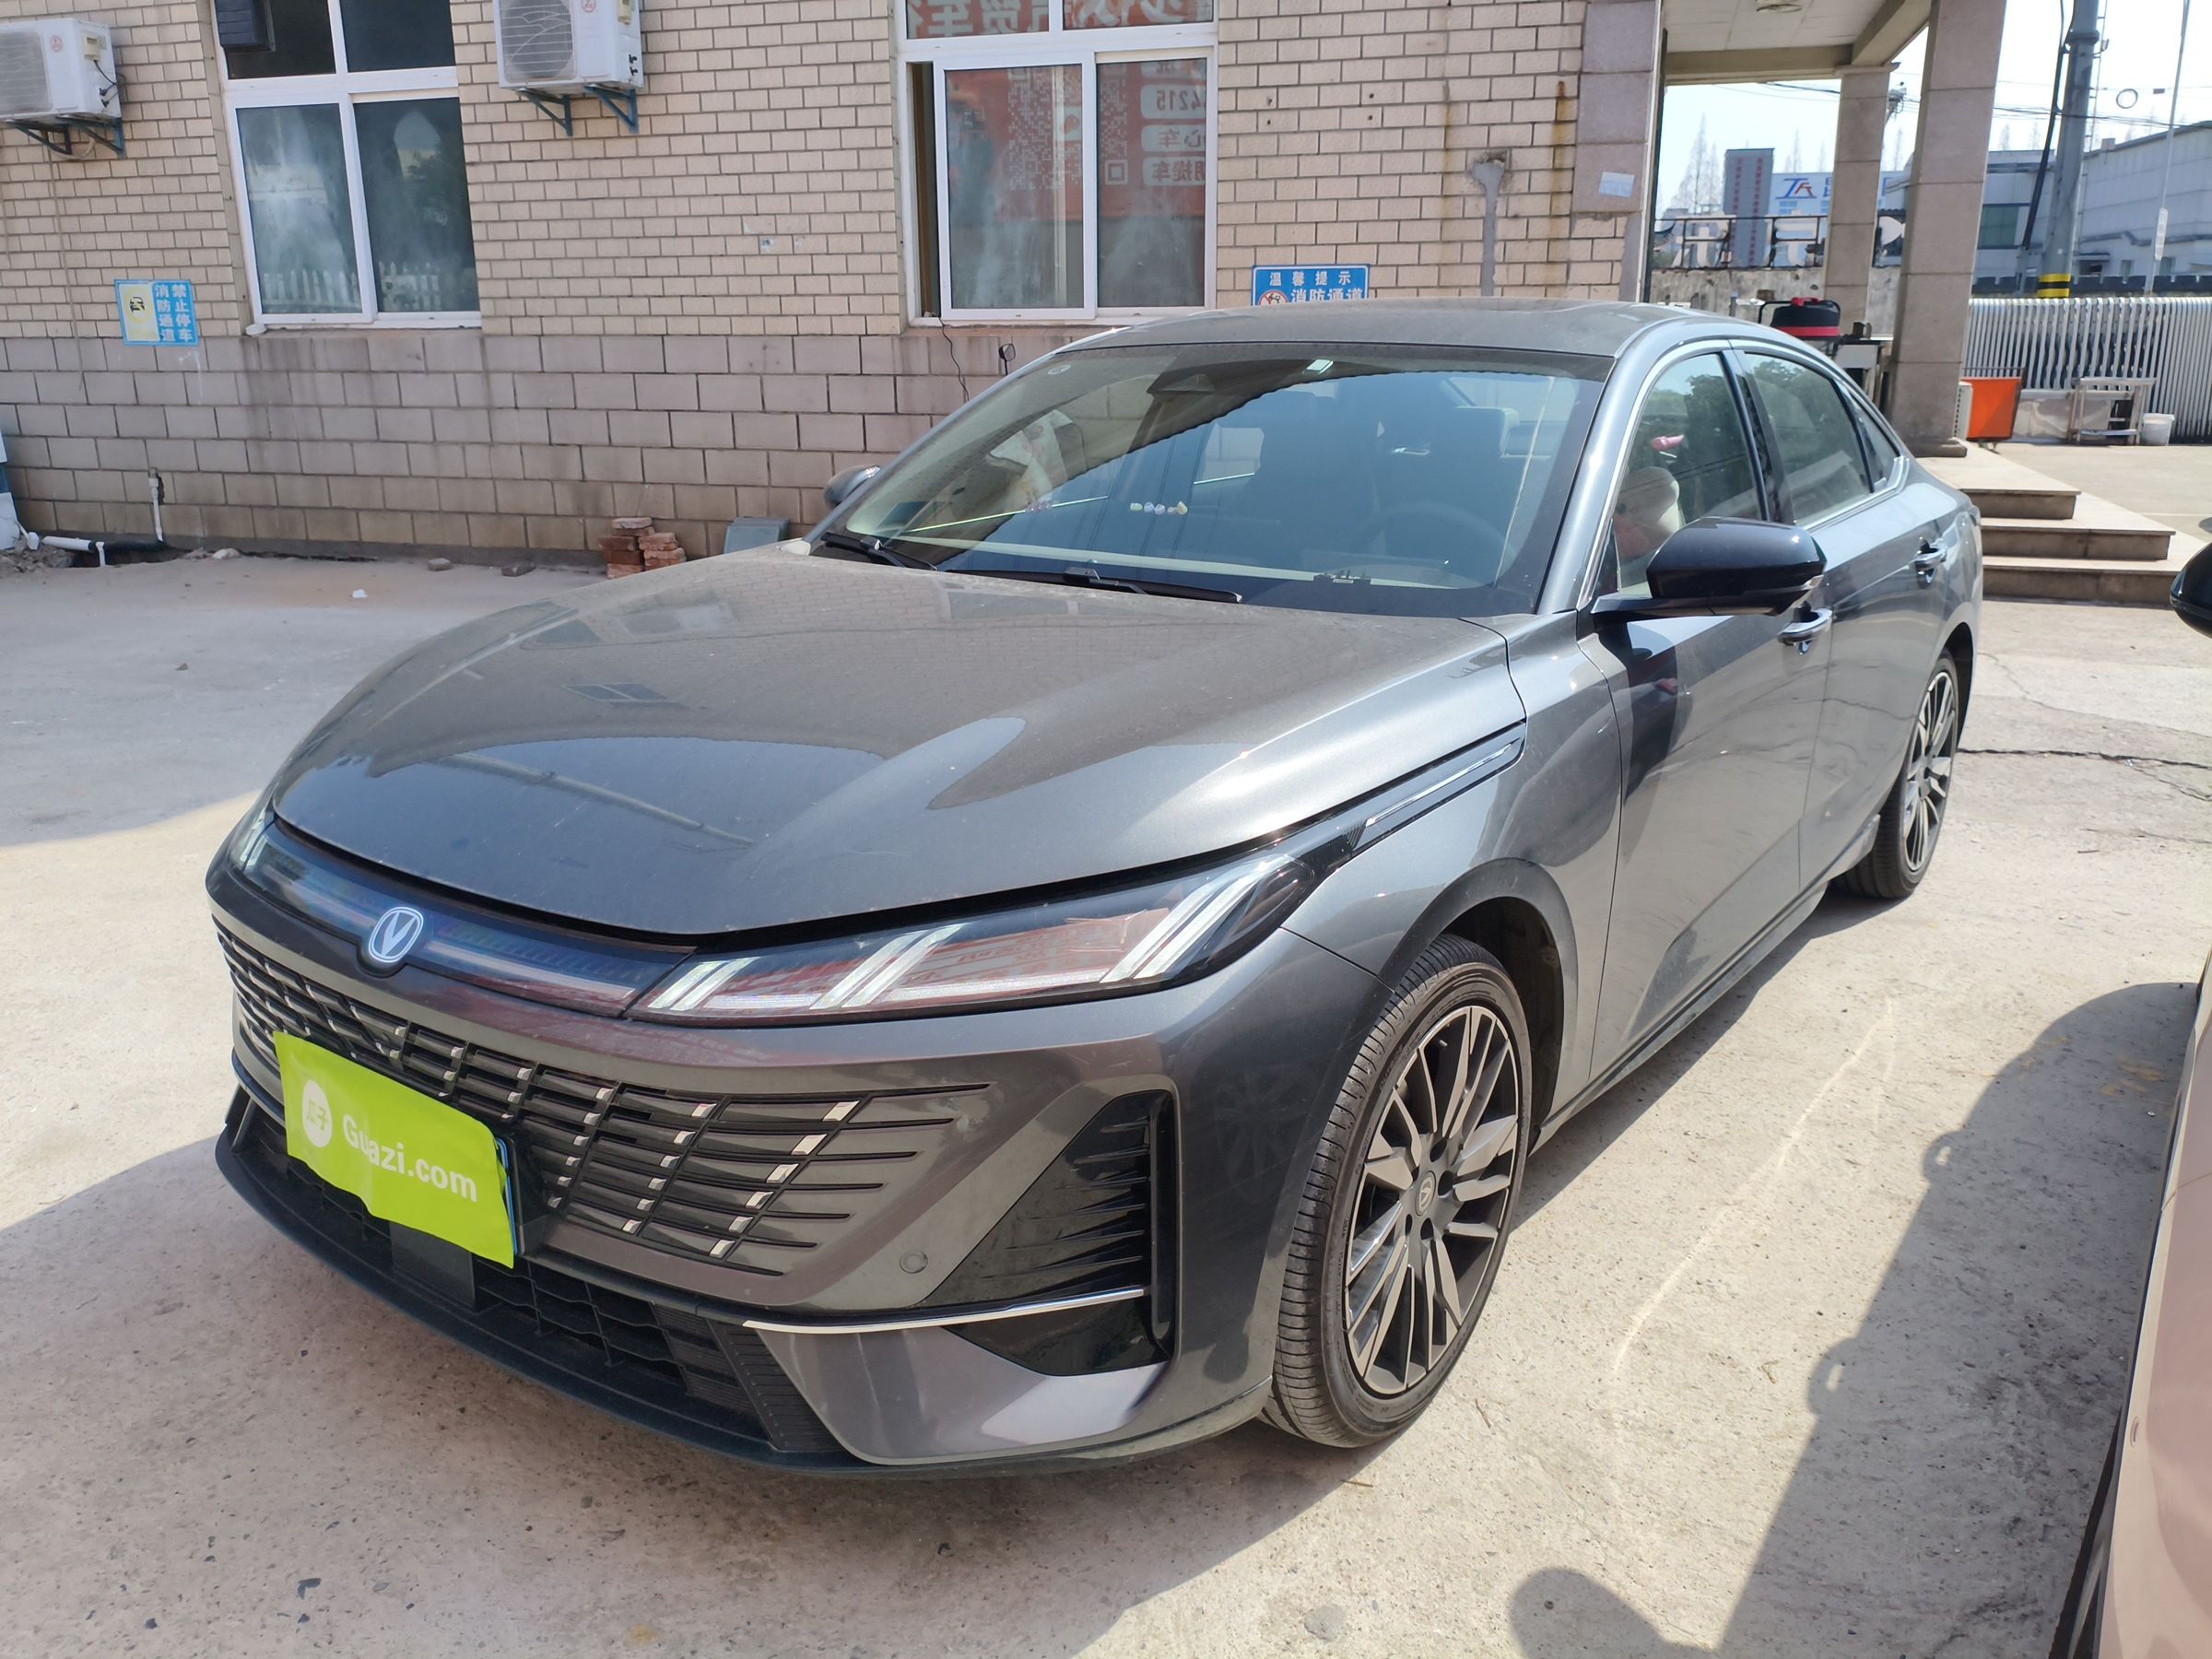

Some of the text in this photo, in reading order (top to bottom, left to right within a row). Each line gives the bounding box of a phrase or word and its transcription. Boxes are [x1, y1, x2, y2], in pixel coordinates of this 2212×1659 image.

[1269, 270, 1351, 287] 温馨提示
[1290, 288, 1363, 303] 消防通道
[154, 284, 176, 342] 消防通道
[172, 284, 194, 343] 禁止停车
[342, 1113, 478, 1203] Guazi.com
